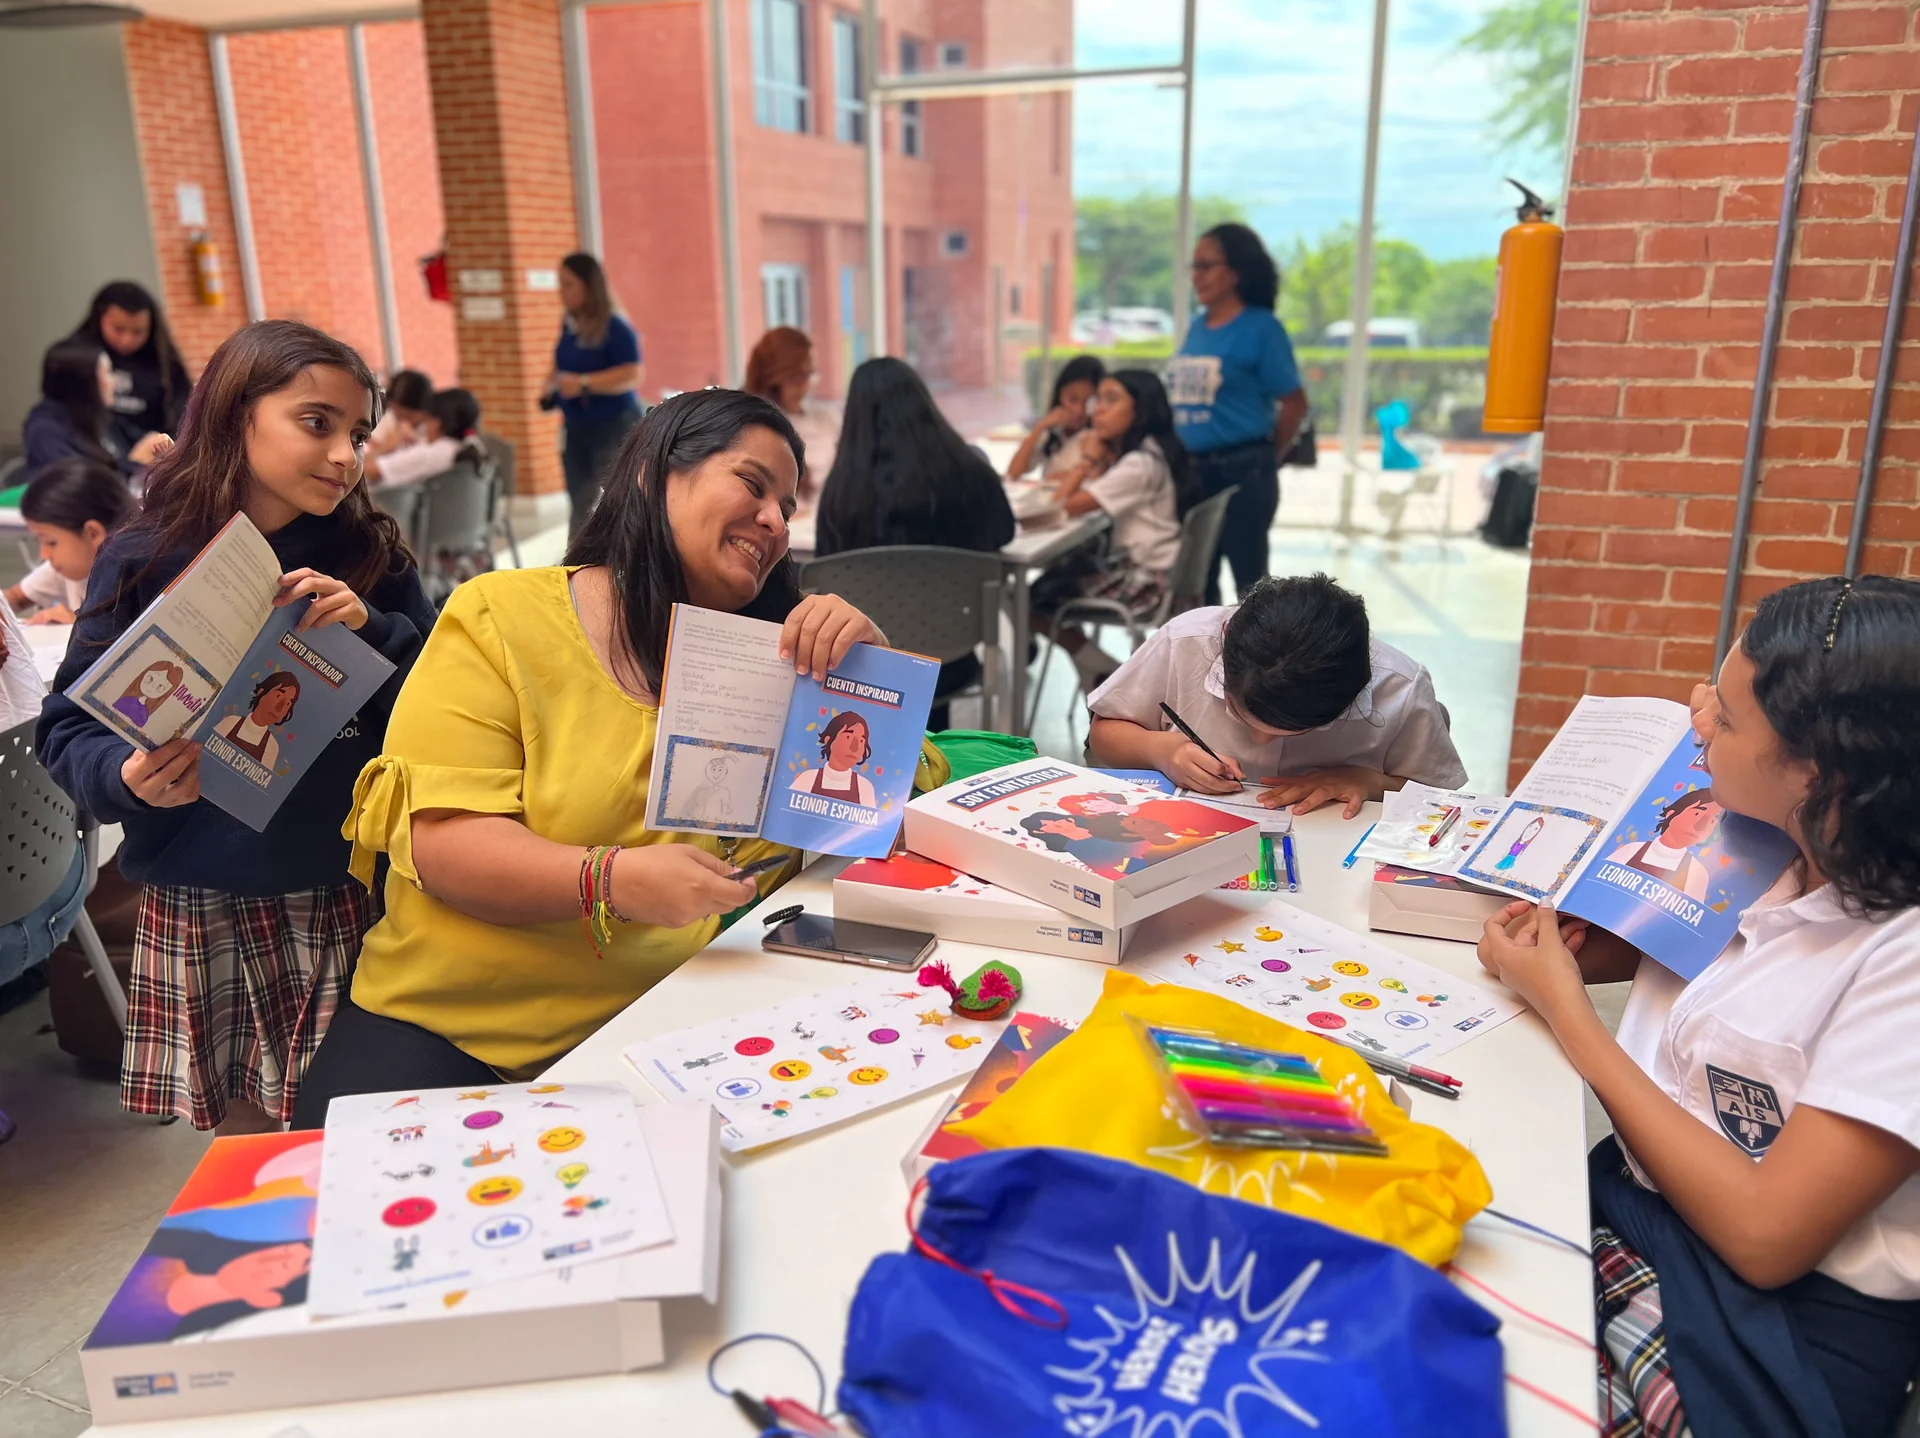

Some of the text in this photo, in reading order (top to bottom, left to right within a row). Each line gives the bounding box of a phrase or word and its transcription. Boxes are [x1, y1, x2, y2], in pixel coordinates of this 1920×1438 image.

[282, 633, 307, 657] CUENTO
[304, 650, 343, 683] INSPIRADOR
[826, 676, 900, 704] CUENTO INSPIRADOR
[204, 733, 272, 788] LEONOR ESPINOSA
[956, 790, 991, 807] SOY
[983, 768, 1069, 796] FANTÁSTICA
[789, 793, 879, 826] LEONOR ESPINOSA
[1596, 863, 1705, 927] LEONOR ESPINOSA
[1082, 936, 1102, 944] United
[1729, 1101, 1766, 1121] AIS
